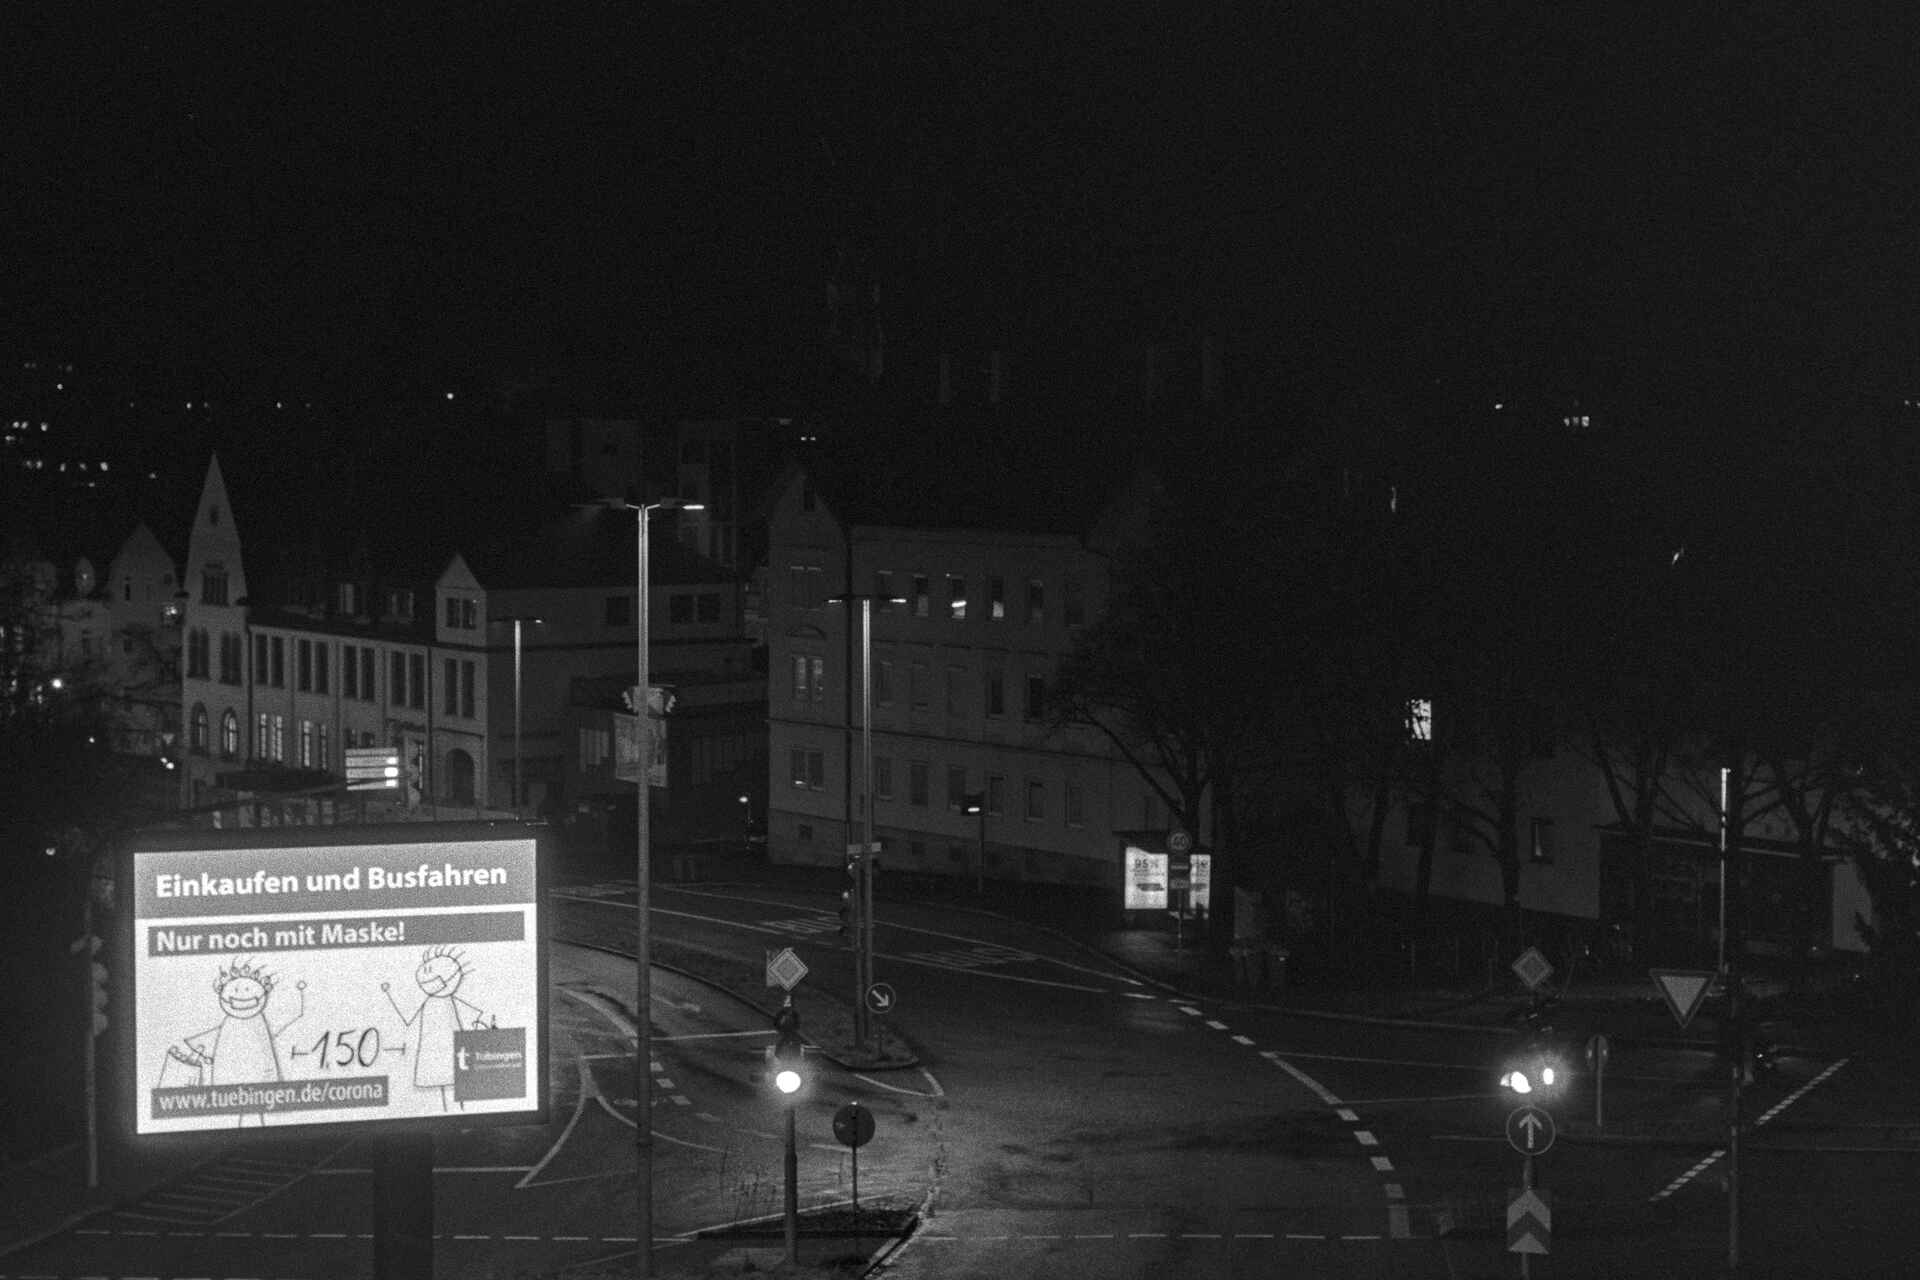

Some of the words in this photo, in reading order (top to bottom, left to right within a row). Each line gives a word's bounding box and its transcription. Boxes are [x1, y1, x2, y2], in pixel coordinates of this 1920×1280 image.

[156, 871, 298, 897] Einkaufen
[307, 867, 360, 892] und
[368, 863, 507, 889] Busfahren
[156, 929, 204, 951] Nur
[208, 925, 268, 949] noch
[275, 925, 315, 946] mit
[321, 921, 405, 944] Maske!
[160, 1083, 383, 1110] www.tuebingen.de/corona
